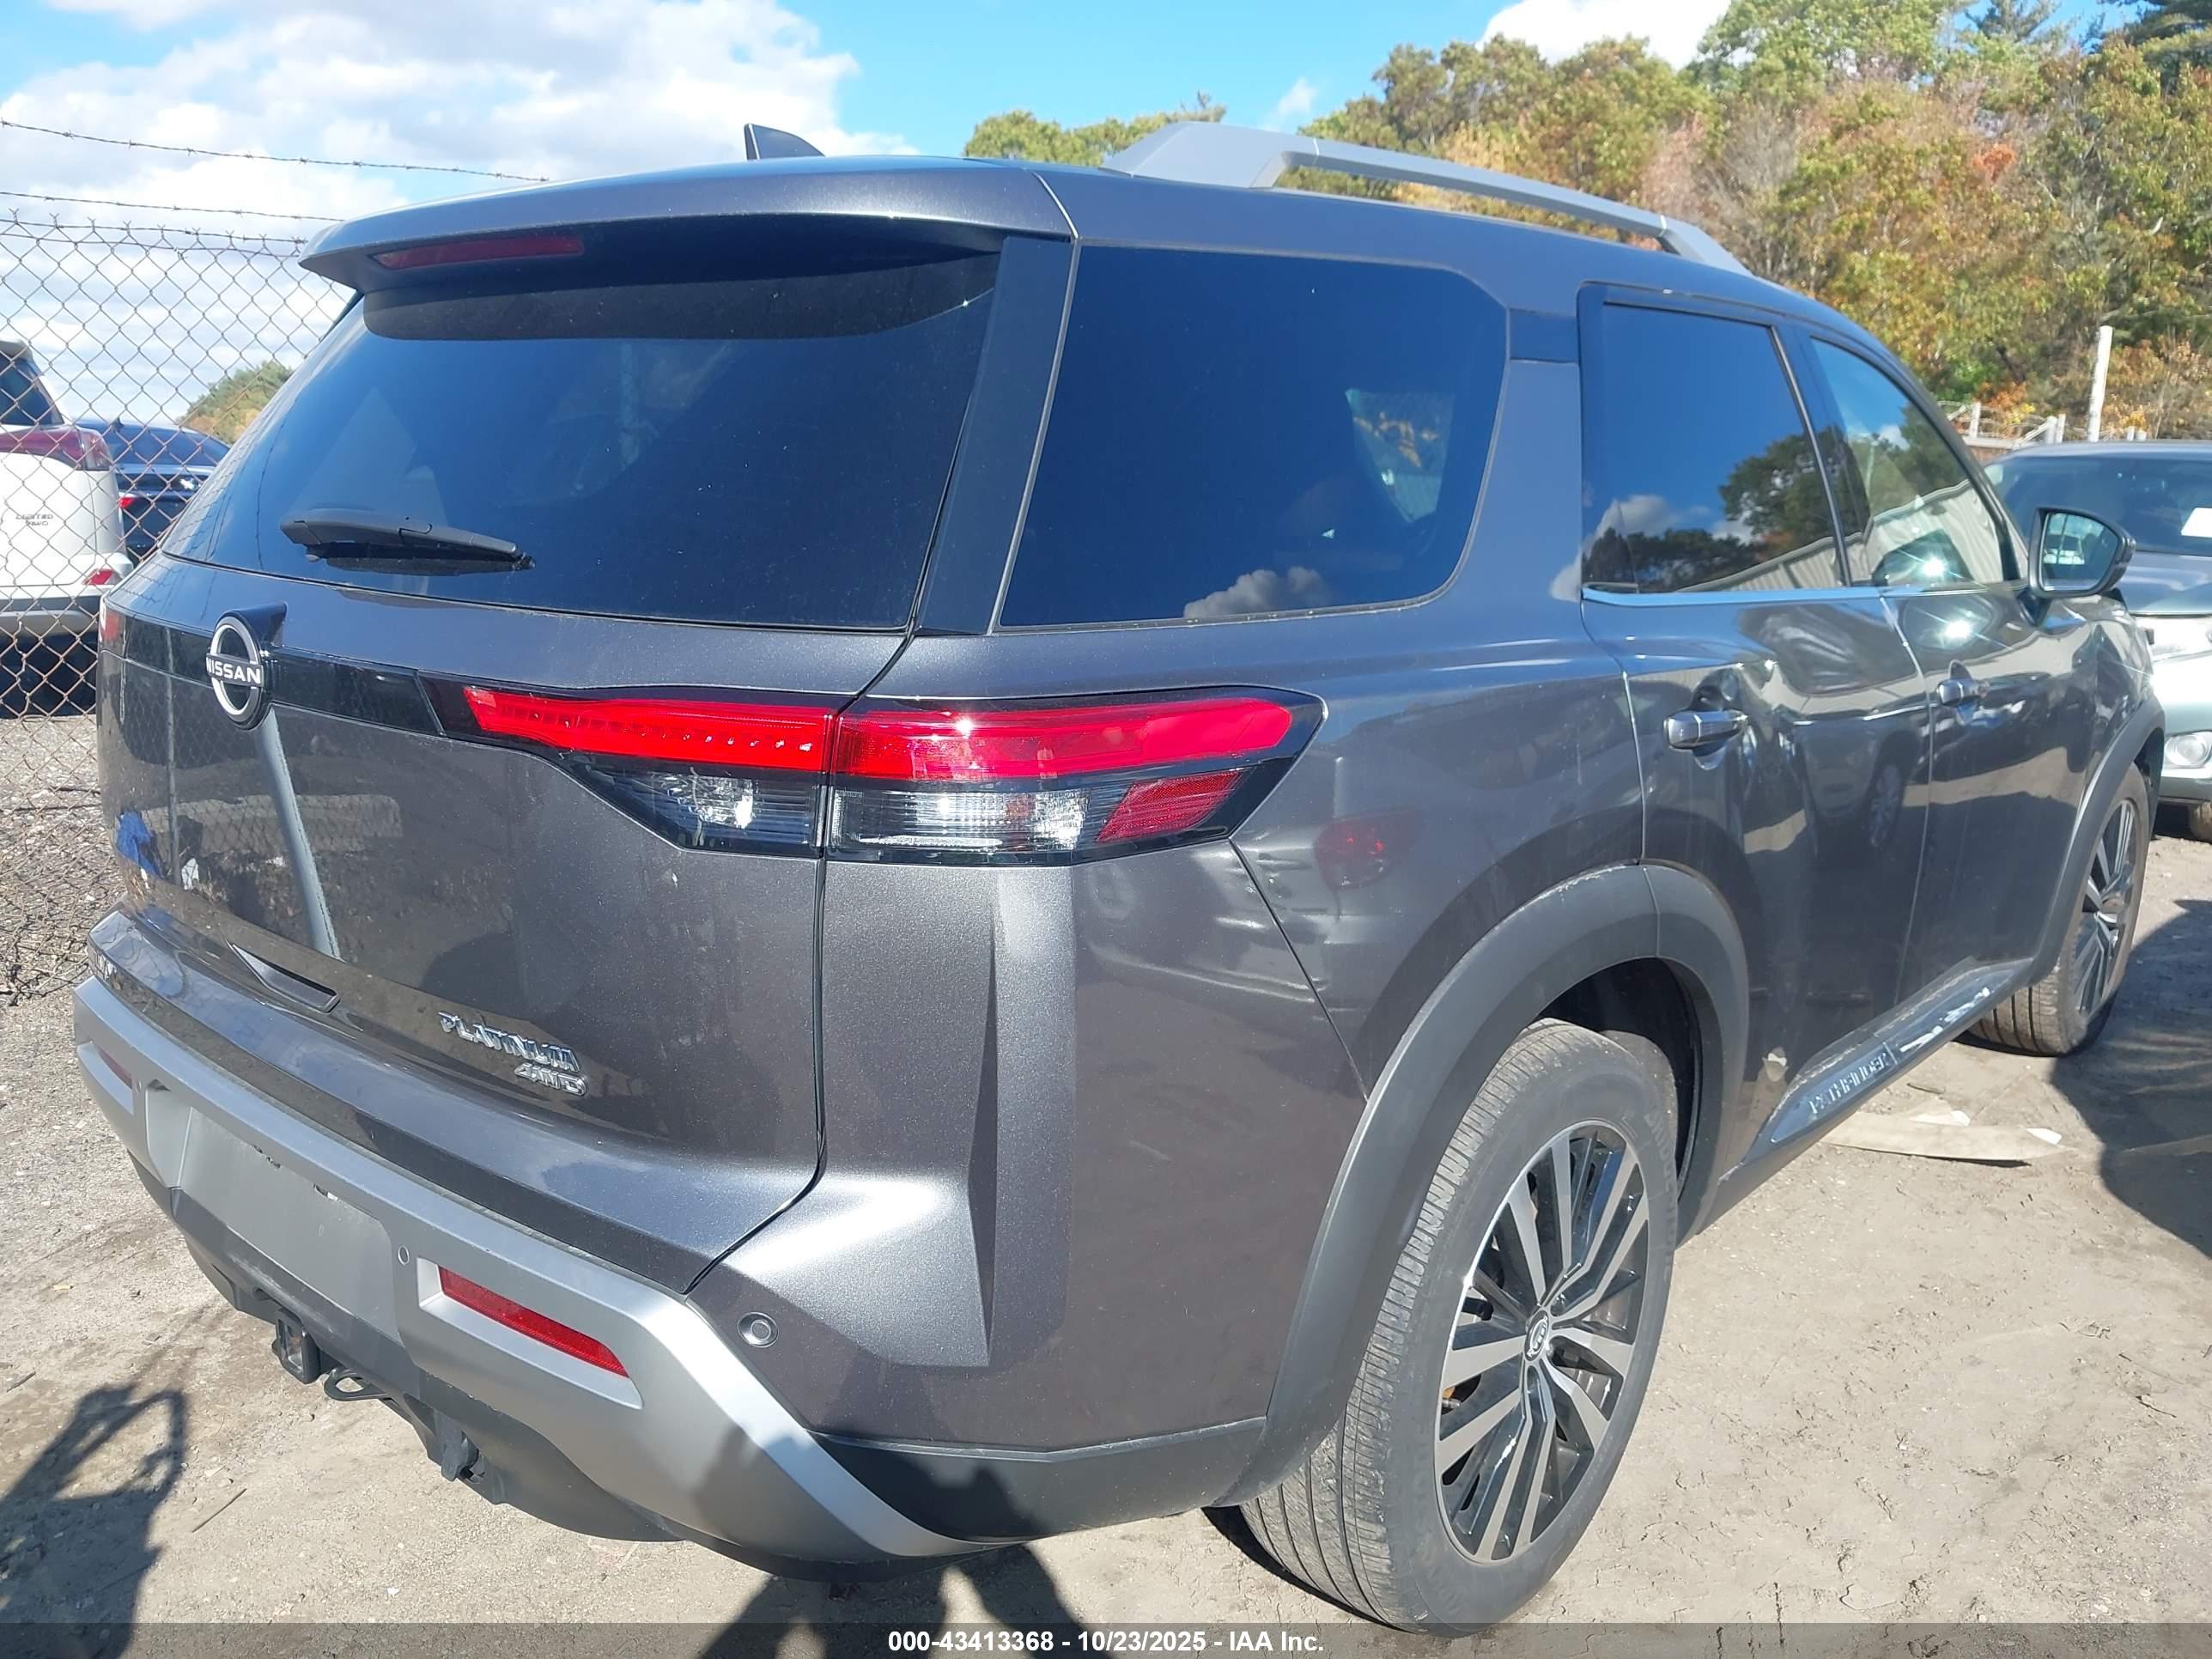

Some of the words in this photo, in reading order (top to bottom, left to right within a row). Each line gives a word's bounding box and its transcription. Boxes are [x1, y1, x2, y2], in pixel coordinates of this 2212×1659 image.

[205, 656, 261, 684] NISSAN
[438, 1012, 580, 1073] PLATINUM
[514, 1062, 586, 1096] 4WD
